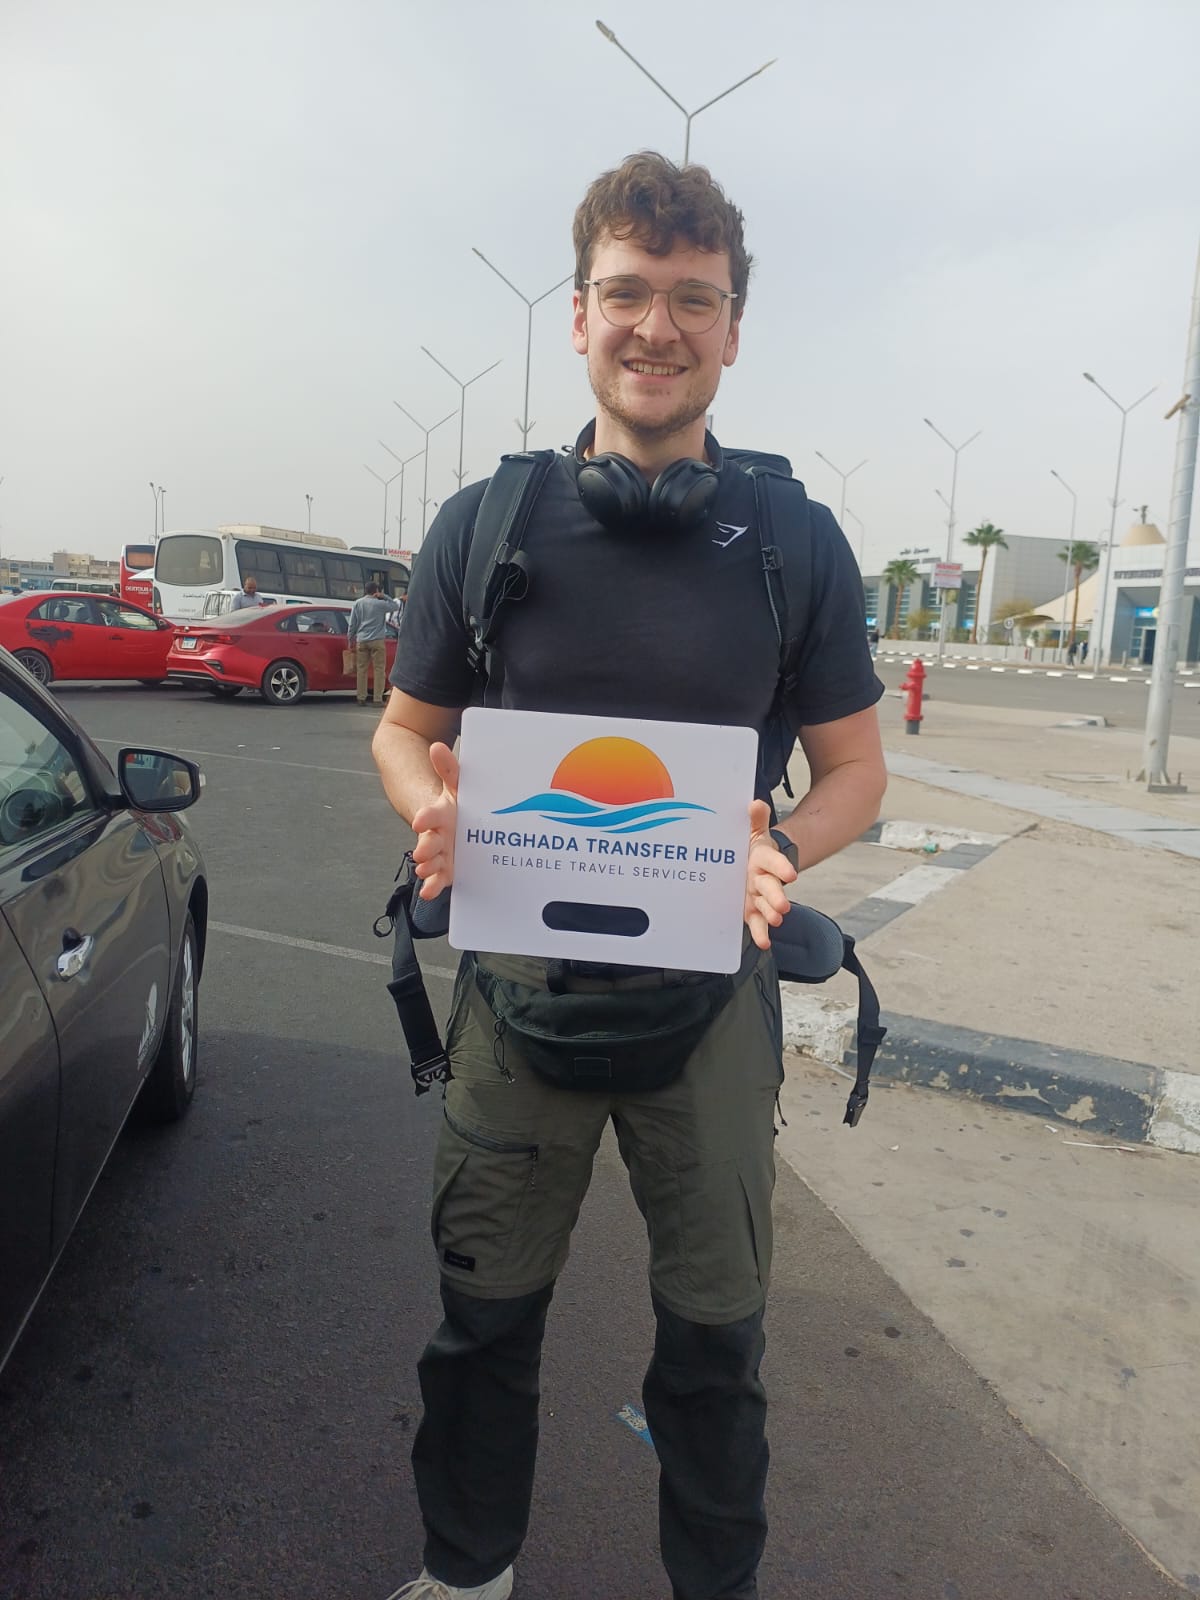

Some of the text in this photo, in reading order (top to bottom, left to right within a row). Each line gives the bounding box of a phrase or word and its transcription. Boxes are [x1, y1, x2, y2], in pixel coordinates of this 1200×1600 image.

[467, 828, 736, 865] HURGHADA TRANSFER HUB
[492, 854, 707, 882] RELIABLE TRAVEL SERVICES
